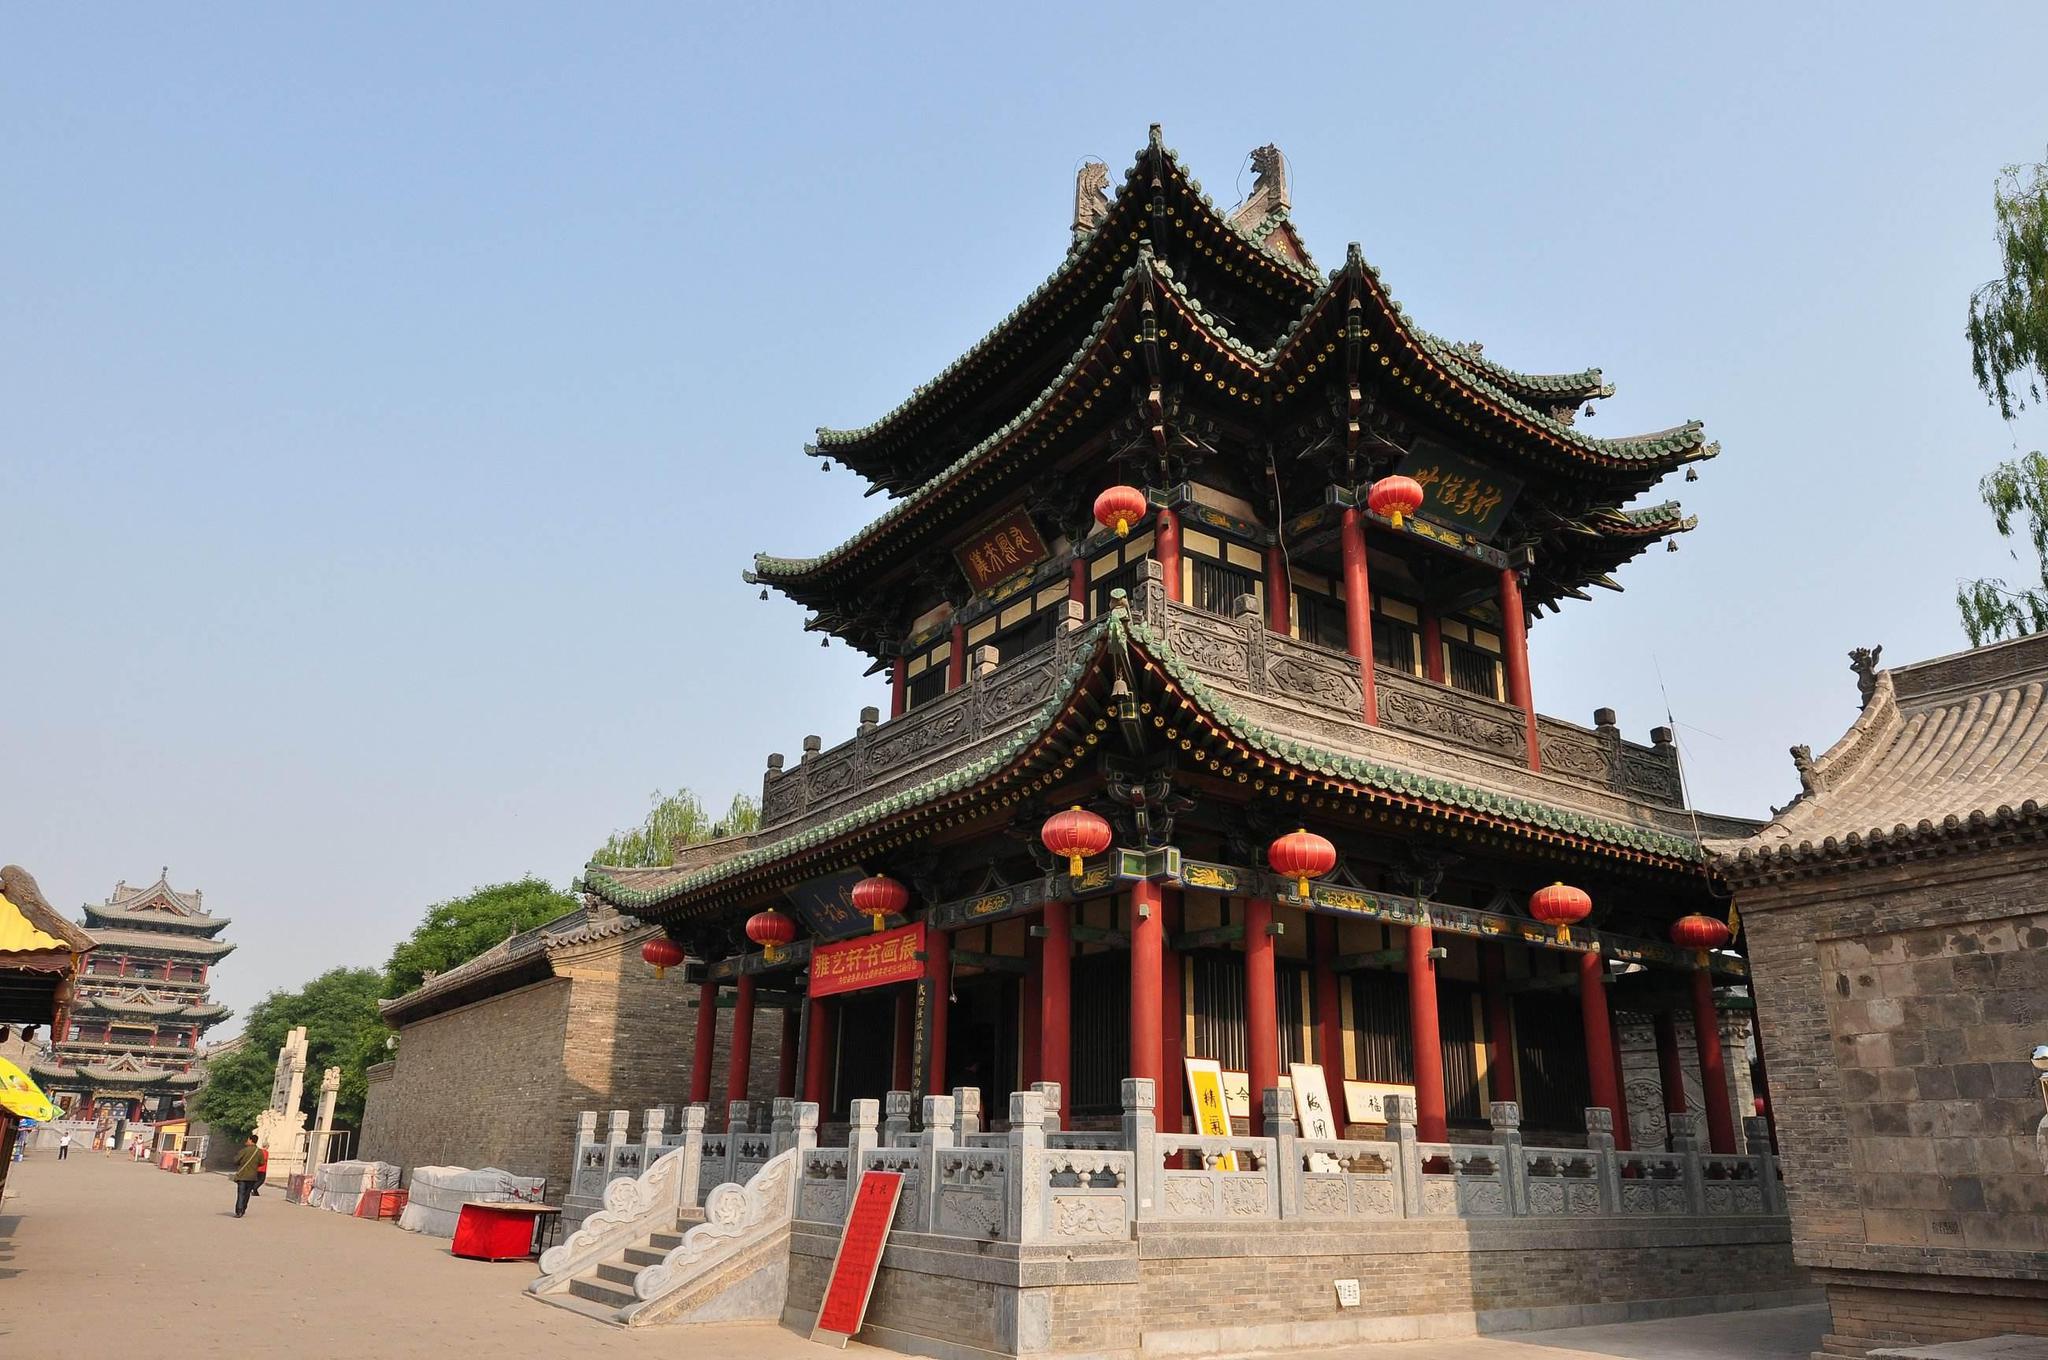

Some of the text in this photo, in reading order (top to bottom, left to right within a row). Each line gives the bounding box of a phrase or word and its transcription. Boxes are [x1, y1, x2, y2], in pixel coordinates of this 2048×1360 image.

[814, 932, 918, 978] 雅艺轩书画展
